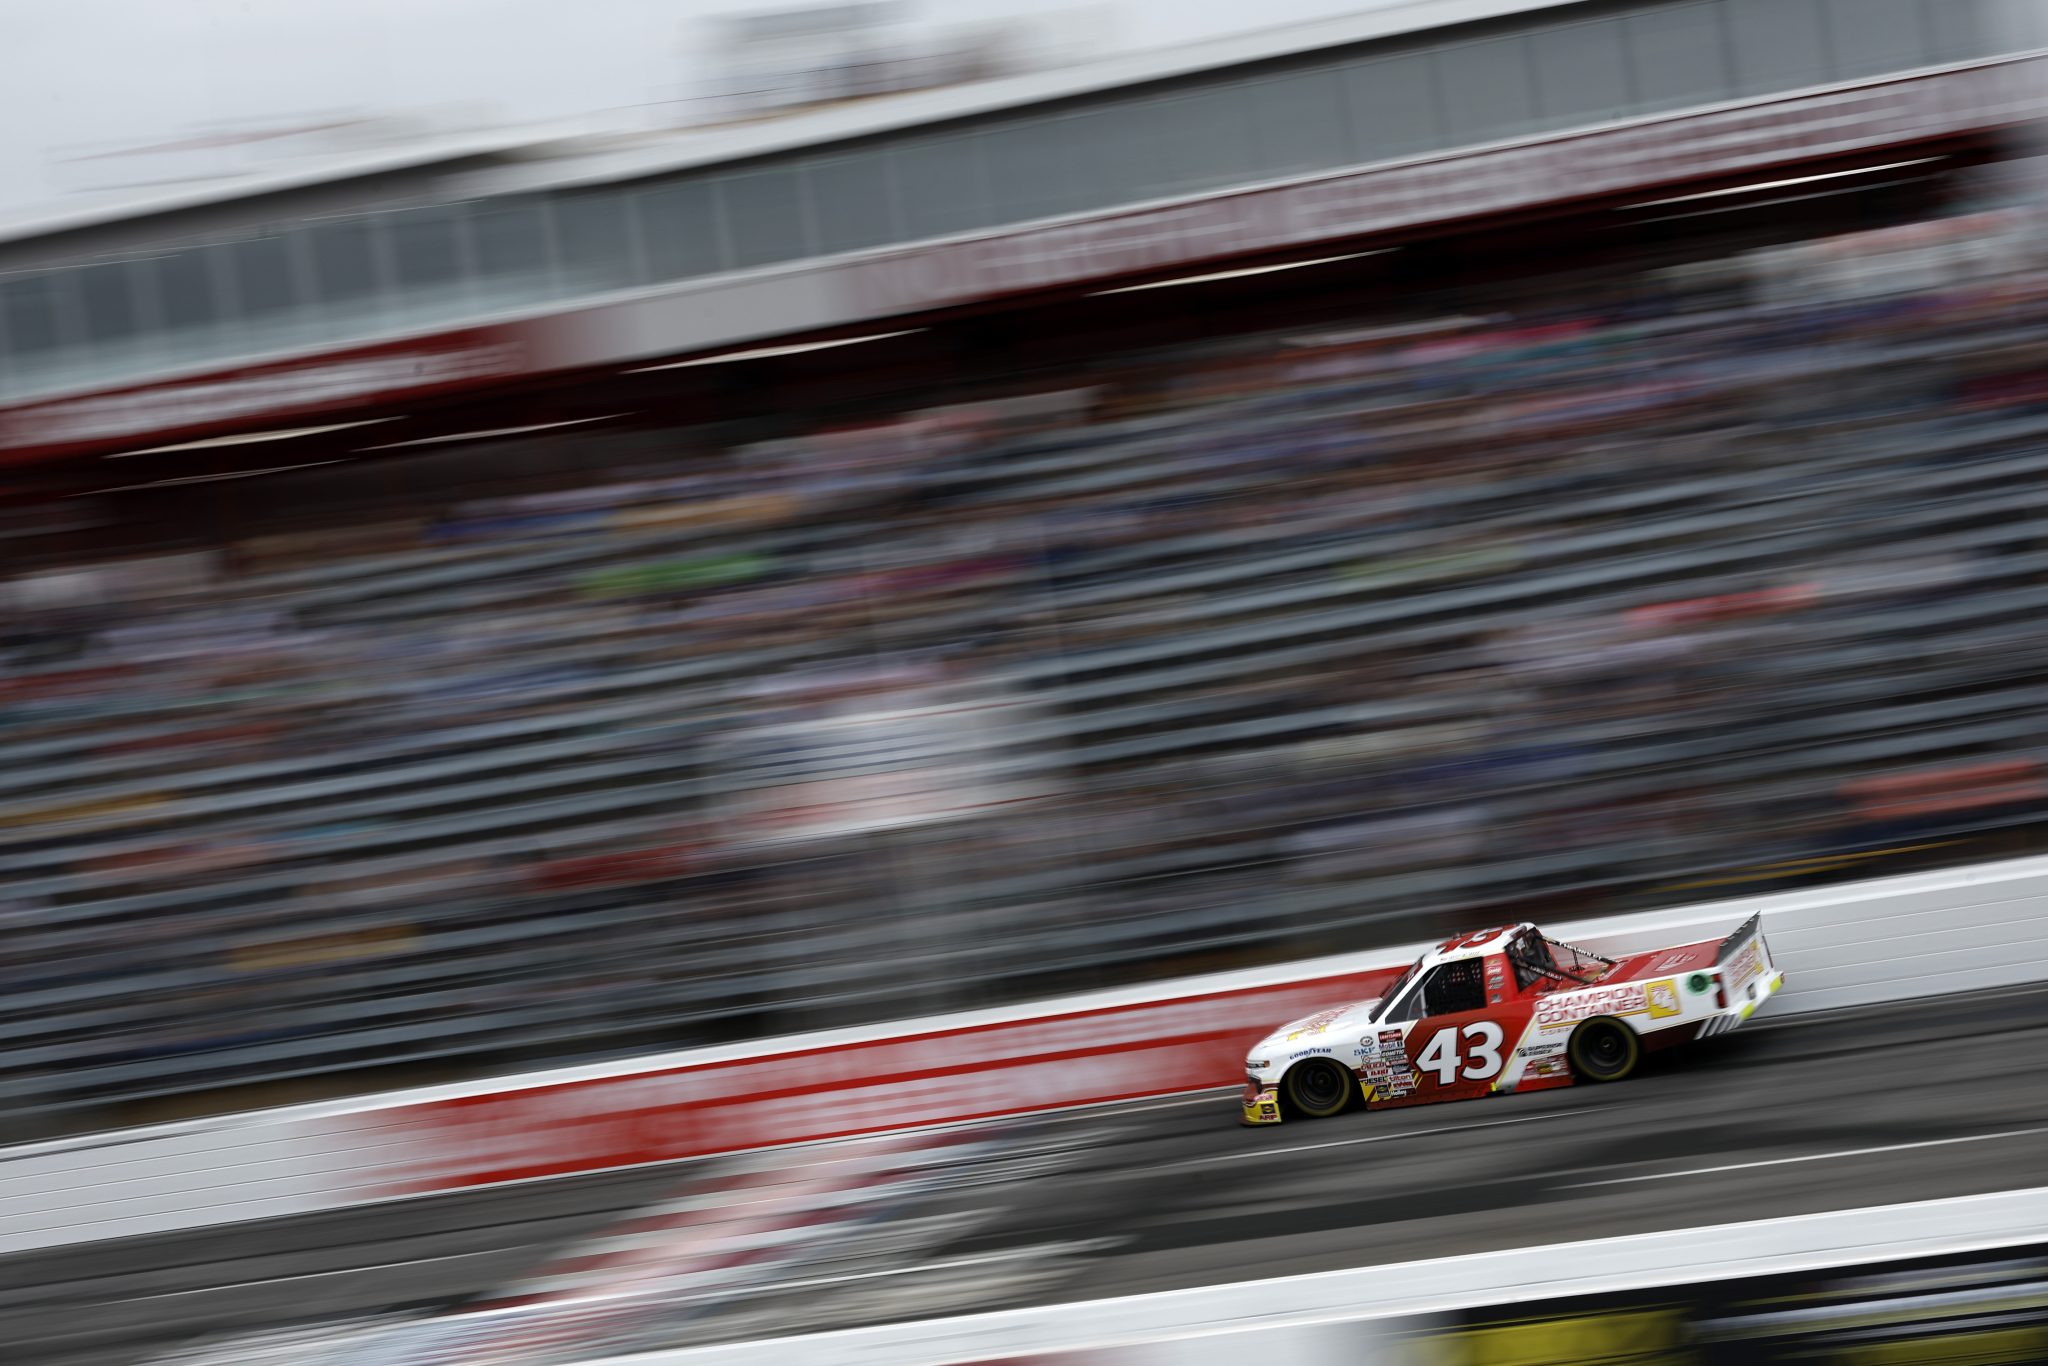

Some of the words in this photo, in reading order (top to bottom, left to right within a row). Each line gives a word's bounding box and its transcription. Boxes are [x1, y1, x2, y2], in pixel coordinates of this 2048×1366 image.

[1535, 984, 1645, 1012] CHAMPION
[1536, 996, 1649, 1024] CONTAINER
[1289, 1047, 1332, 1060] GOODYEAR
[1353, 1047, 1375, 1056] SKF
[1415, 1021, 1504, 1085] 43
